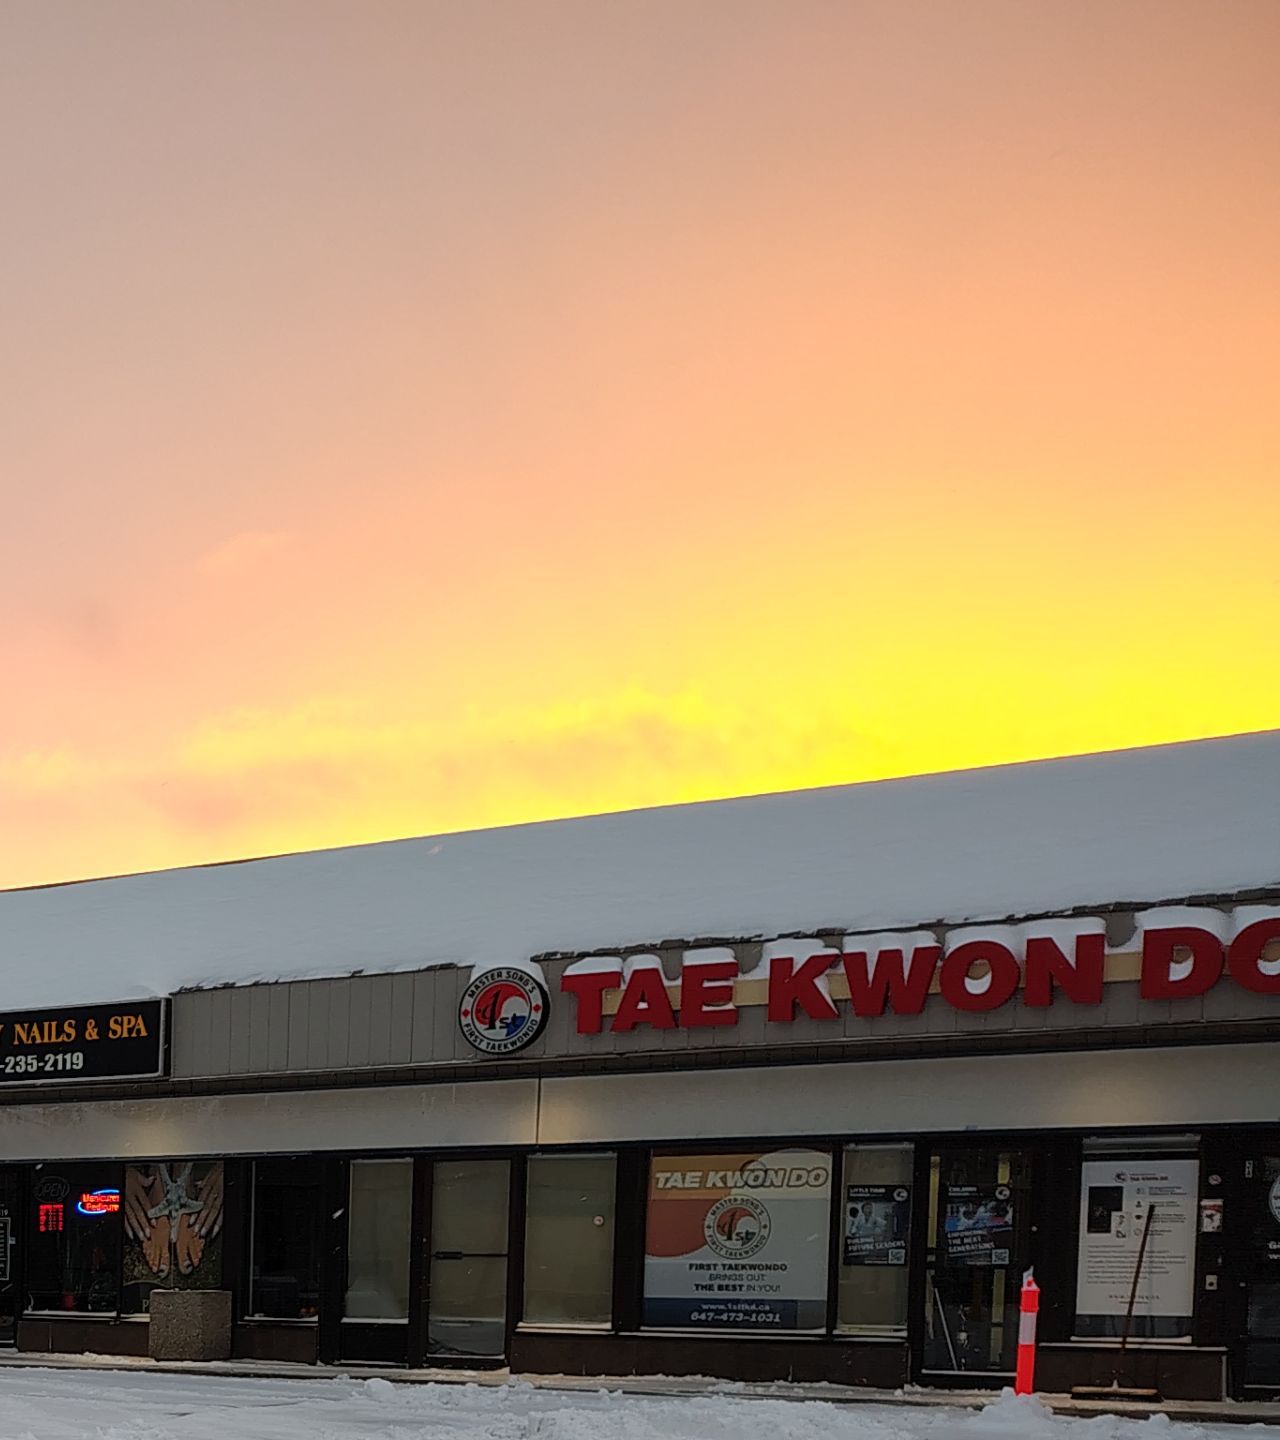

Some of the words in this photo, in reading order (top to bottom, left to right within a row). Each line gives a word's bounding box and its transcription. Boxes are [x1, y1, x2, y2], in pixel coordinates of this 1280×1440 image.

[468, 971, 503, 999] MASTER
[505, 970, 537, 994] SONG'S
[561, 961, 738, 1035] TAE
[768, 930, 1106, 1023] KWON
[1140, 917, 1280, 1000] DO
[13, 1020, 76, 1045] NAILS
[85, 1019, 99, 1041] &
[108, 1014, 148, 1040] SPA
[464, 1023, 485, 1045] FIRST
[486, 1019, 538, 1051] TAEKWONDO
[655, 1171, 702, 1188] TAE
[705, 1168, 786, 1188] KWON
[787, 1167, 829, 1188] DO
[711, 1197, 740, 1217] MASTER
[707, 1234, 724, 1253] FIRST
[725, 1234, 767, 1258] TAEKWONDO
[689, 1263, 718, 1271] FIRST
[722, 1263, 788, 1271] TAEKWONDO
[708, 1273, 744, 1281] BRINGS
[694, 1284, 714, 1292] THE
[717, 1284, 744, 1292] BEST
[691, 1312, 781, 1322] 647-473-1031
